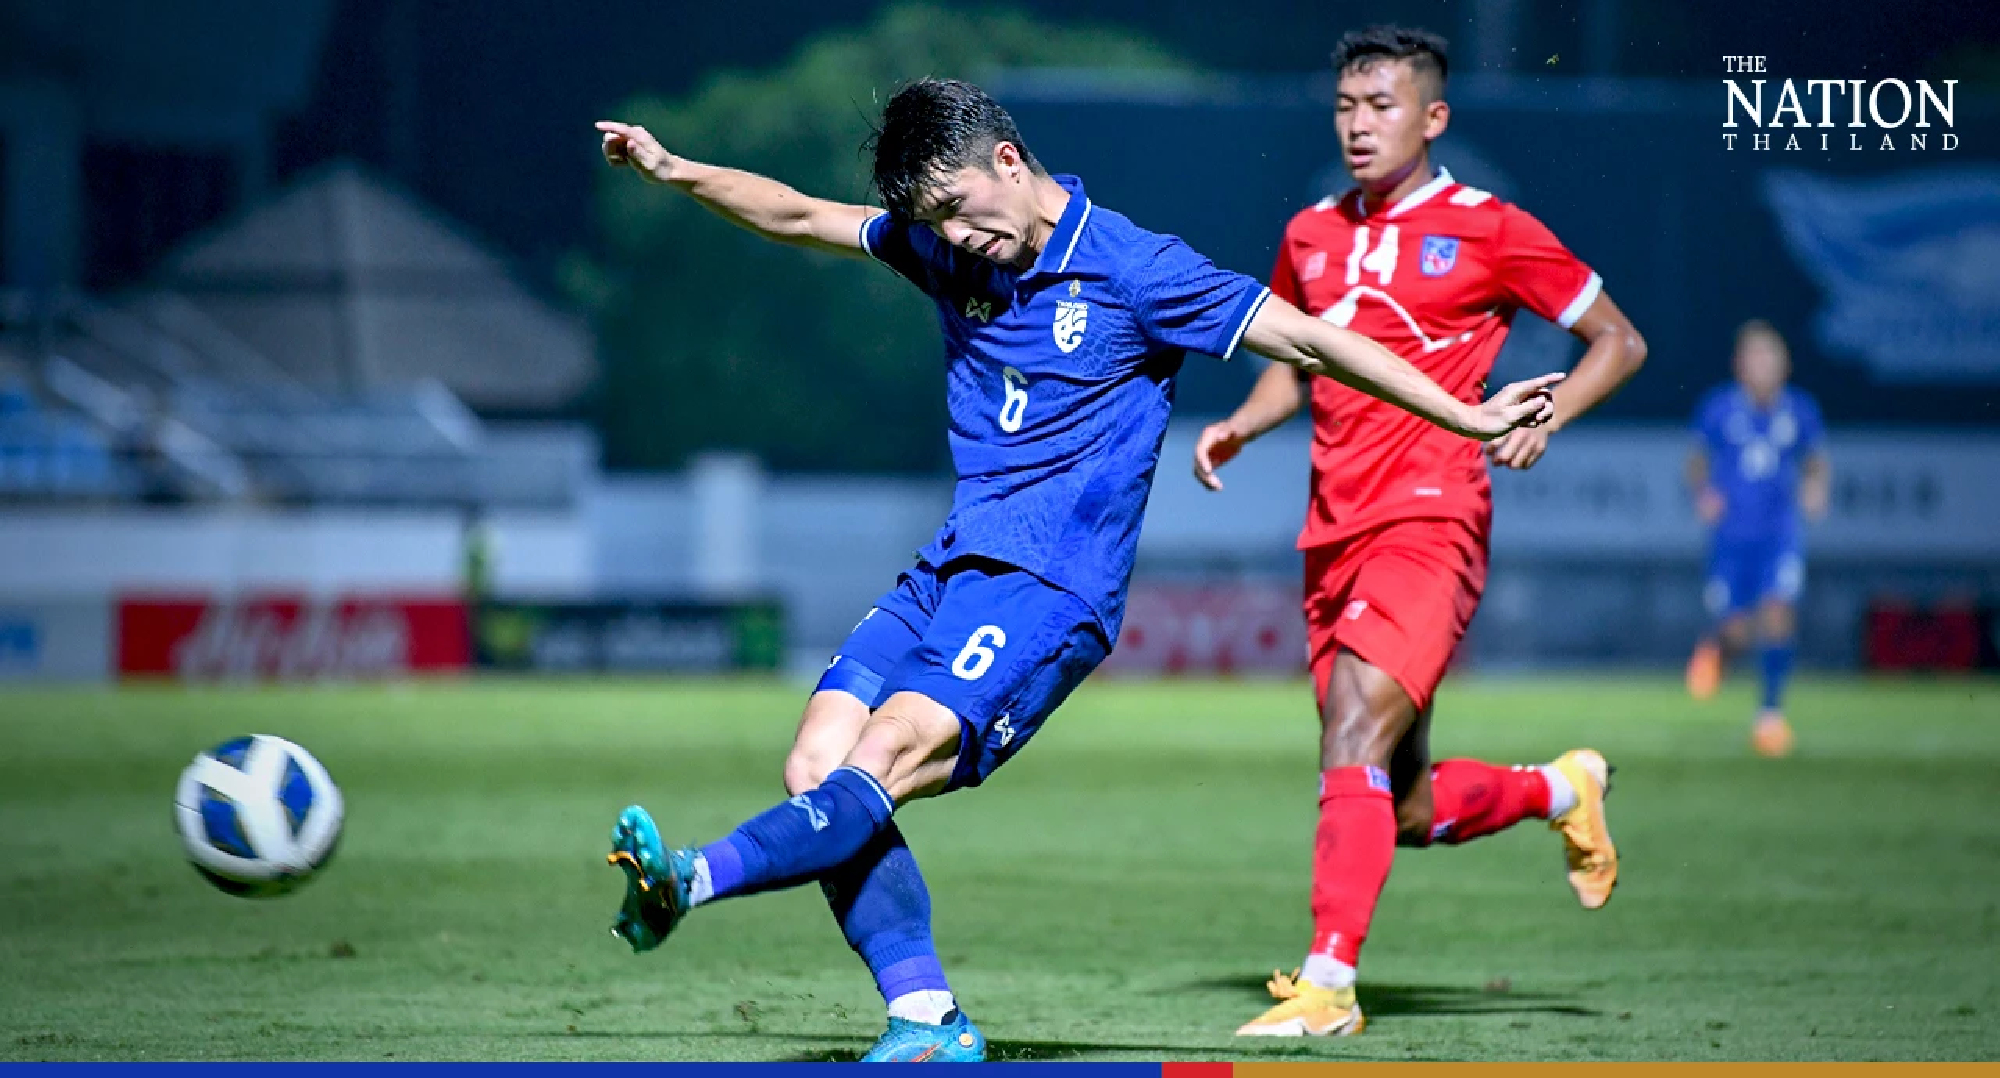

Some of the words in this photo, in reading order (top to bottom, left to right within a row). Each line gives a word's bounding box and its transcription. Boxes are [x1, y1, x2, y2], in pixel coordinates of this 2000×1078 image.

[1345, 225, 1399, 285] 14
[1000, 366, 1028, 433] 6
[952, 625, 1006, 680] 6
